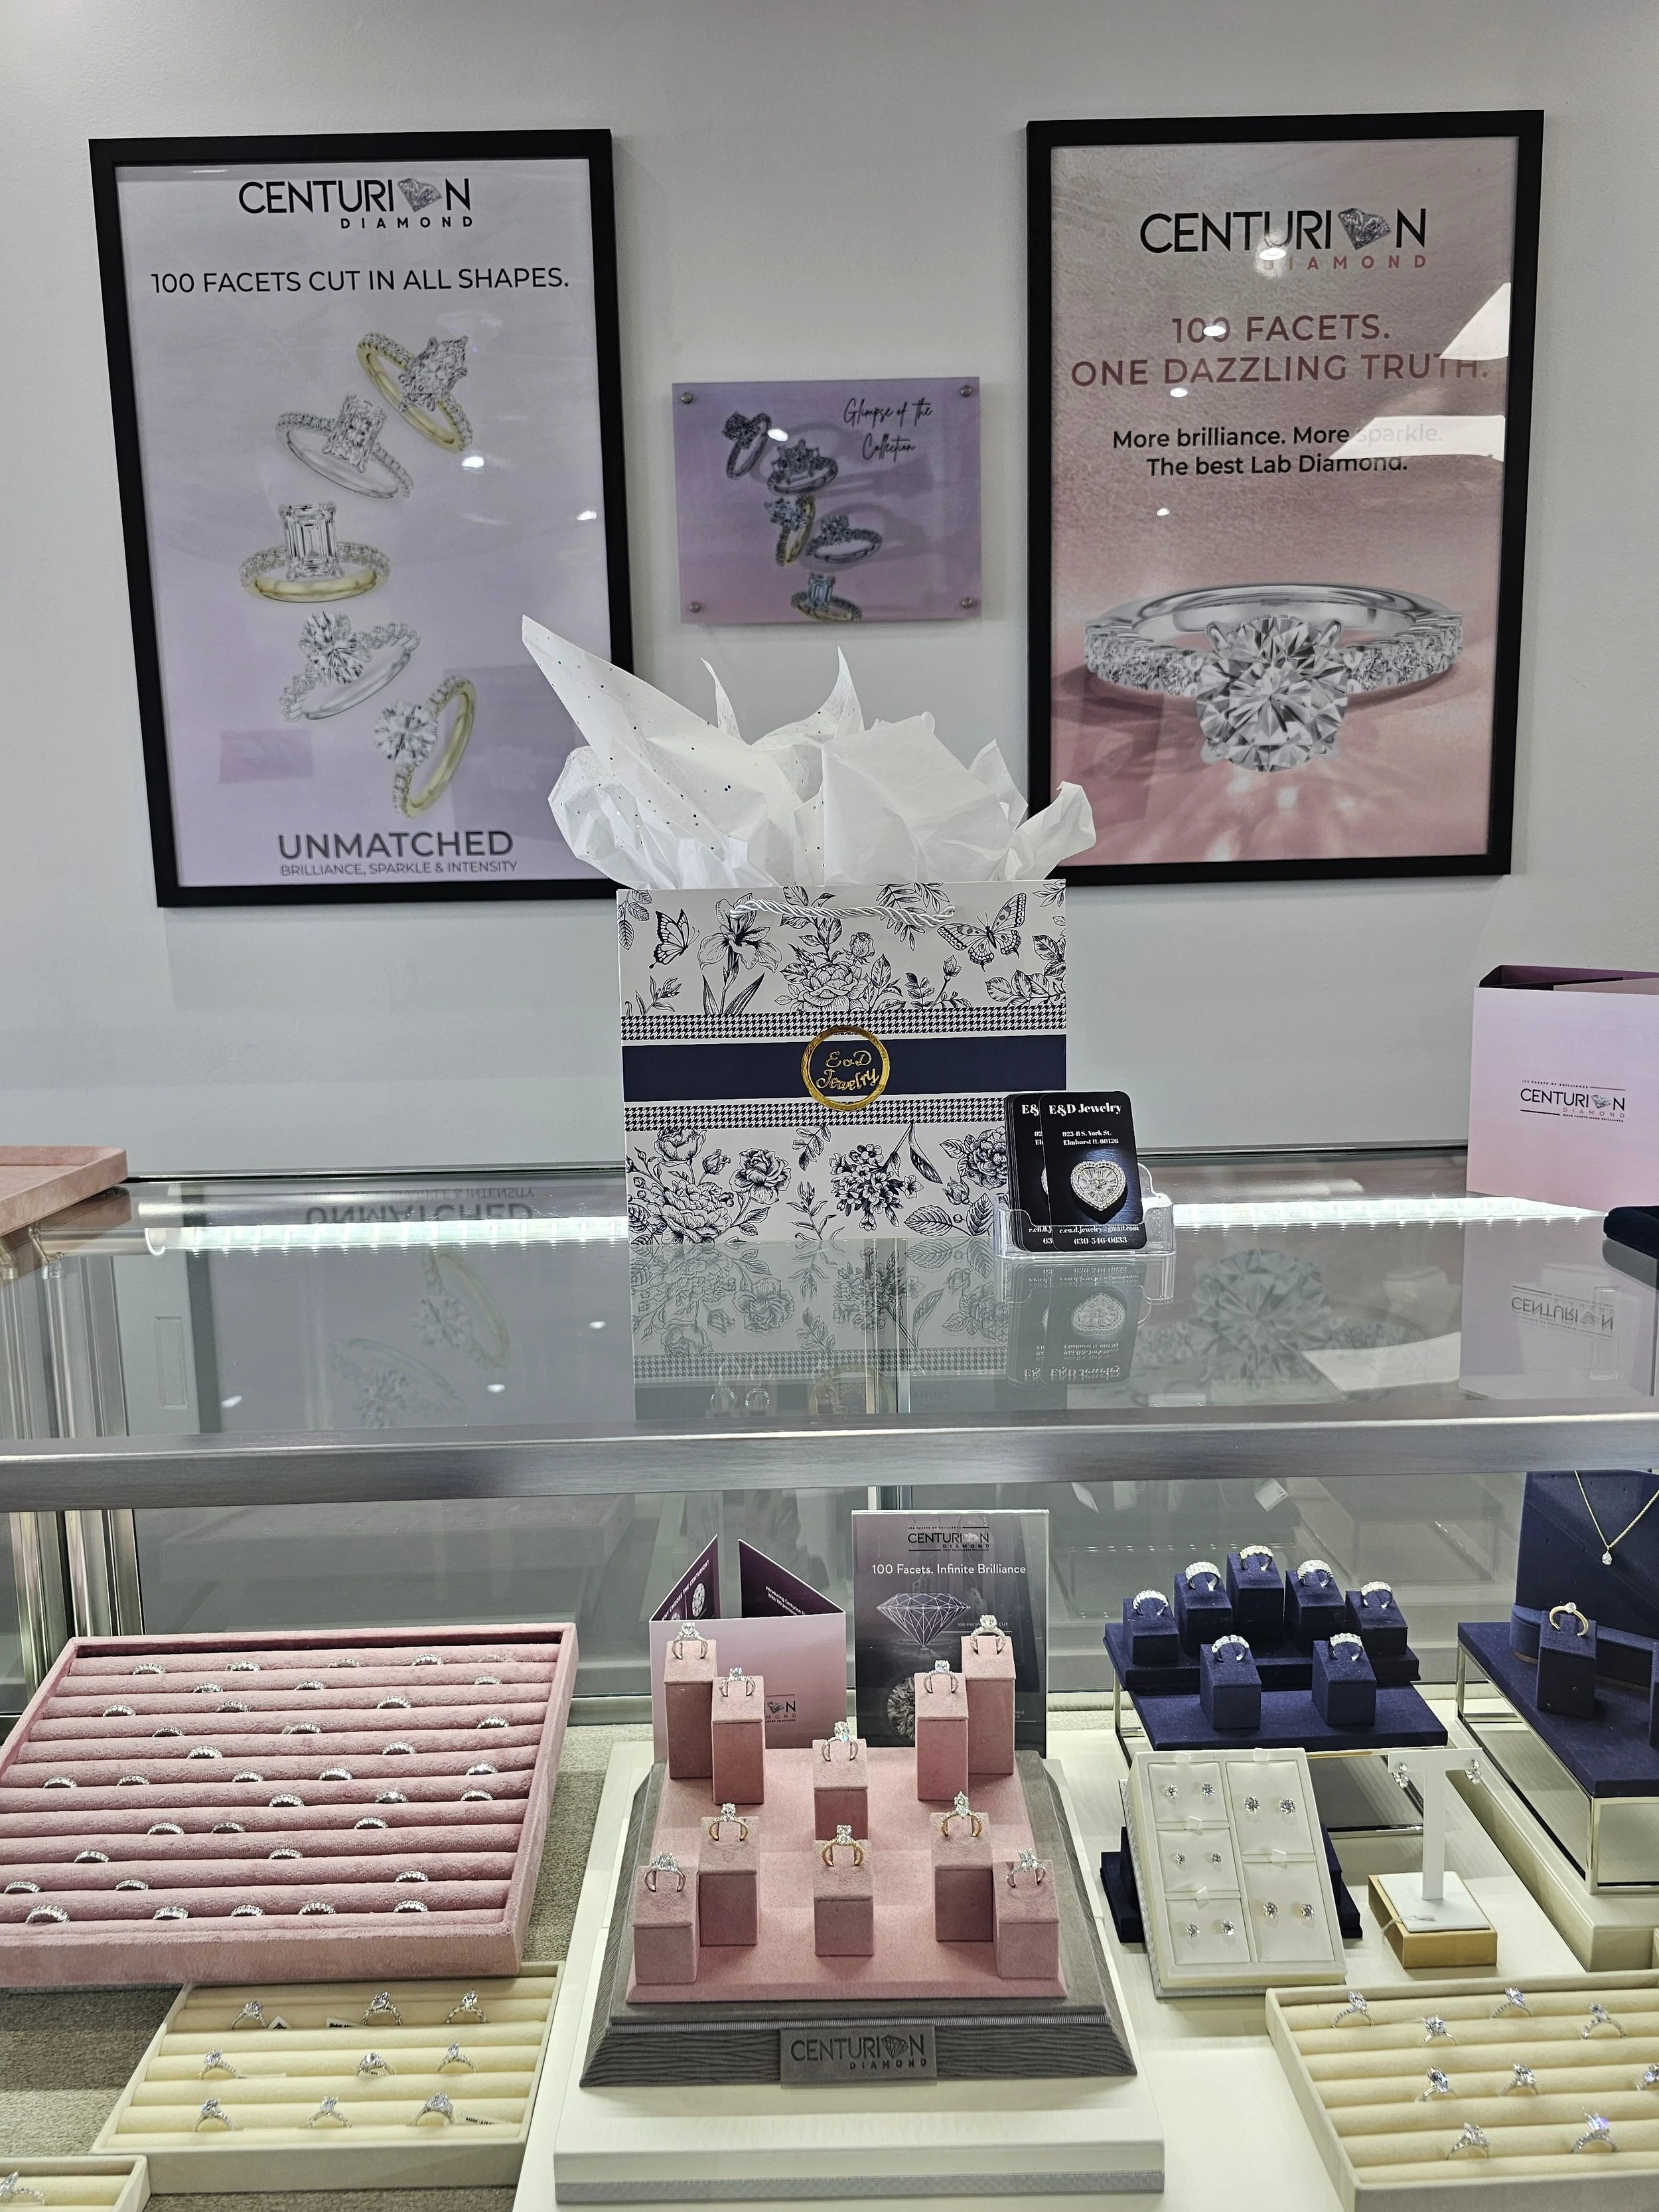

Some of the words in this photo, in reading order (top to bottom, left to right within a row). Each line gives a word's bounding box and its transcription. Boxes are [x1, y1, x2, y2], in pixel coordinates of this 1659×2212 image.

[340, 216, 474, 230] DIAMOND
[151, 273, 195, 293] 100
[202, 271, 301, 293] FACETS
[309, 269, 361, 291] CUT
[368, 269, 395, 291] IN
[403, 268, 453, 290] ALL
[458, 267, 570, 289] SHAPES.
[1171, 316, 1231, 344] 100
[1246, 313, 1391, 342] FACETS.
[1070, 359, 1148, 387] ONE
[1164, 354, 1347, 384] DAZZLING
[1360, 352, 1489, 380] TRUTH.
[843, 398, 894, 429] Glimpse
[896, 400, 908, 429] of
[911, 397, 934, 427] the
[863, 433, 916, 463] Collection
[1112, 430, 1170, 449] More
[1177, 427, 1286, 447] brilliance.
[1293, 426, 1350, 445] More
[1355, 422, 1443, 447] sparkle.
[1146, 458, 1189, 477] The
[1195, 456, 1244, 475] best
[1250, 455, 1292, 474] Lab
[1298, 451, 1408, 473] Diamond.
[277, 830, 515, 861] UNMATCHED
[280, 863, 367, 877] BRILLIANCE,
[369, 861, 432, 875] SPARKLE
[435, 862, 445, 874] &
[447, 860, 518, 873] INTENSITY
[816, 1068, 880, 1091] Jewelry
[1048, 1104, 1077, 1117] E&D
[1078, 1102, 1122, 1115] Jewelry
[1563, 1107, 1625, 1118] DIAMOND
[871, 1564, 893, 1574] 100
[897, 1564, 934, 1574] Facets.
[937, 1563, 975, 1574] Infinite
[977, 1563, 1027, 1574] Brilliance
[849, 2057, 927, 2070] DIAMOND
